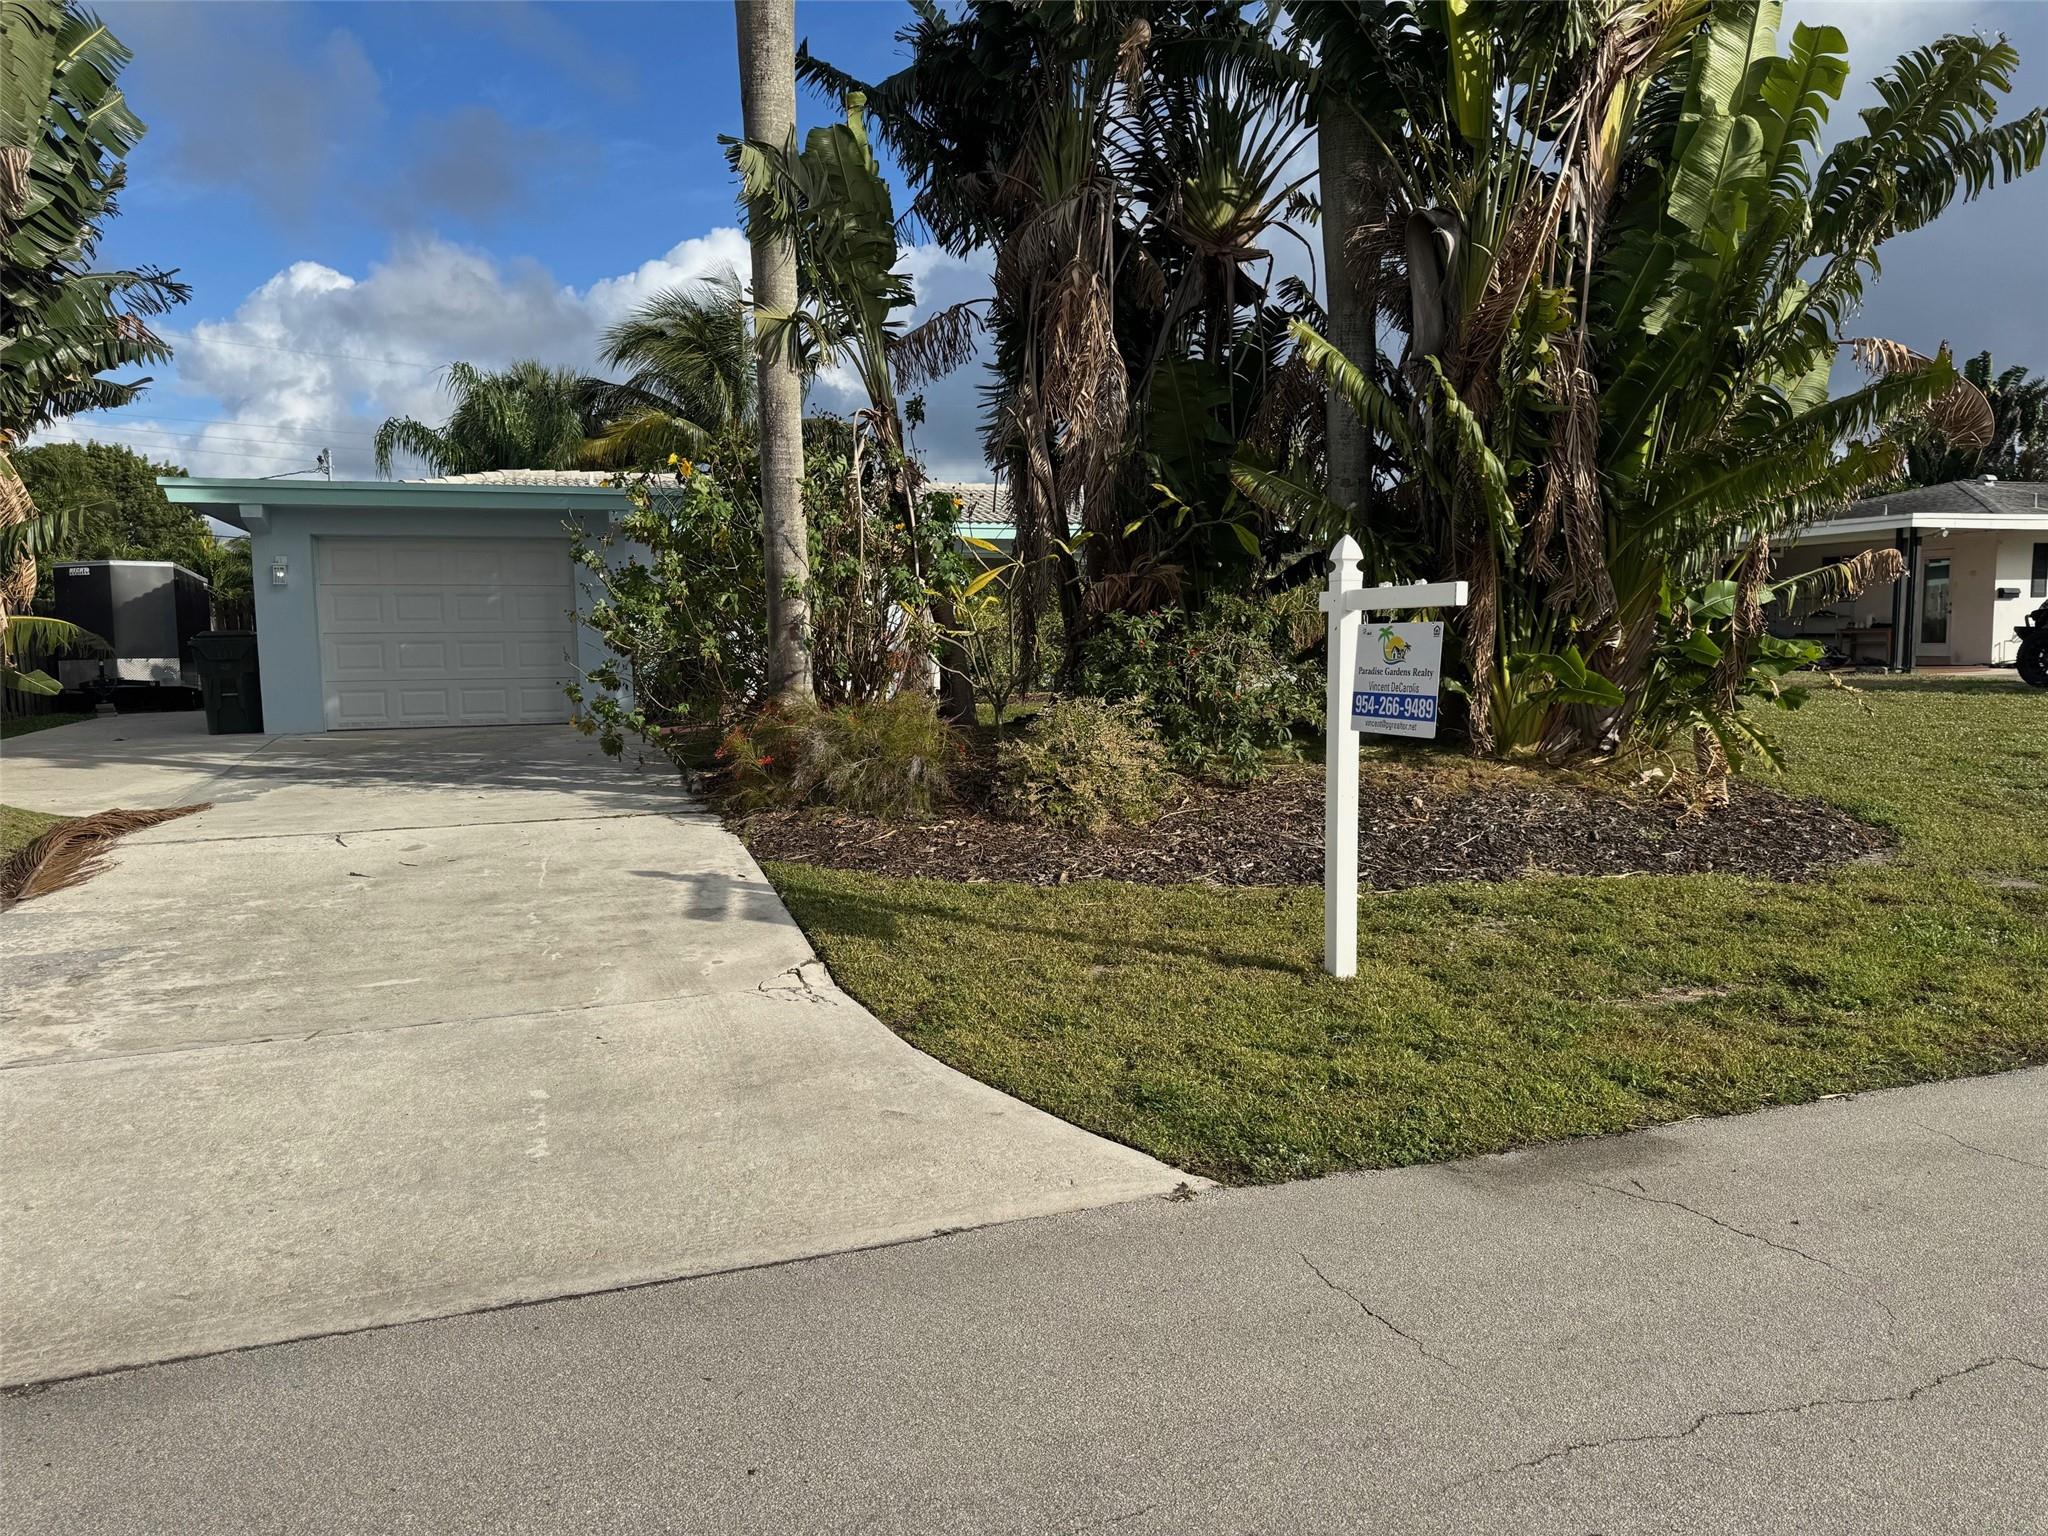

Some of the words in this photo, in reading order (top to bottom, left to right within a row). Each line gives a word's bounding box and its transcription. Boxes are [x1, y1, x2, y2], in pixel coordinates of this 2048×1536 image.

[1359, 667, 1383, 675] Paradise
[1385, 667, 1410, 676] Gardens
[1413, 668, 1434, 680] Realty
[1369, 681, 1390, 691] Vincent
[1355, 695, 1433, 718] 954-266-9489
